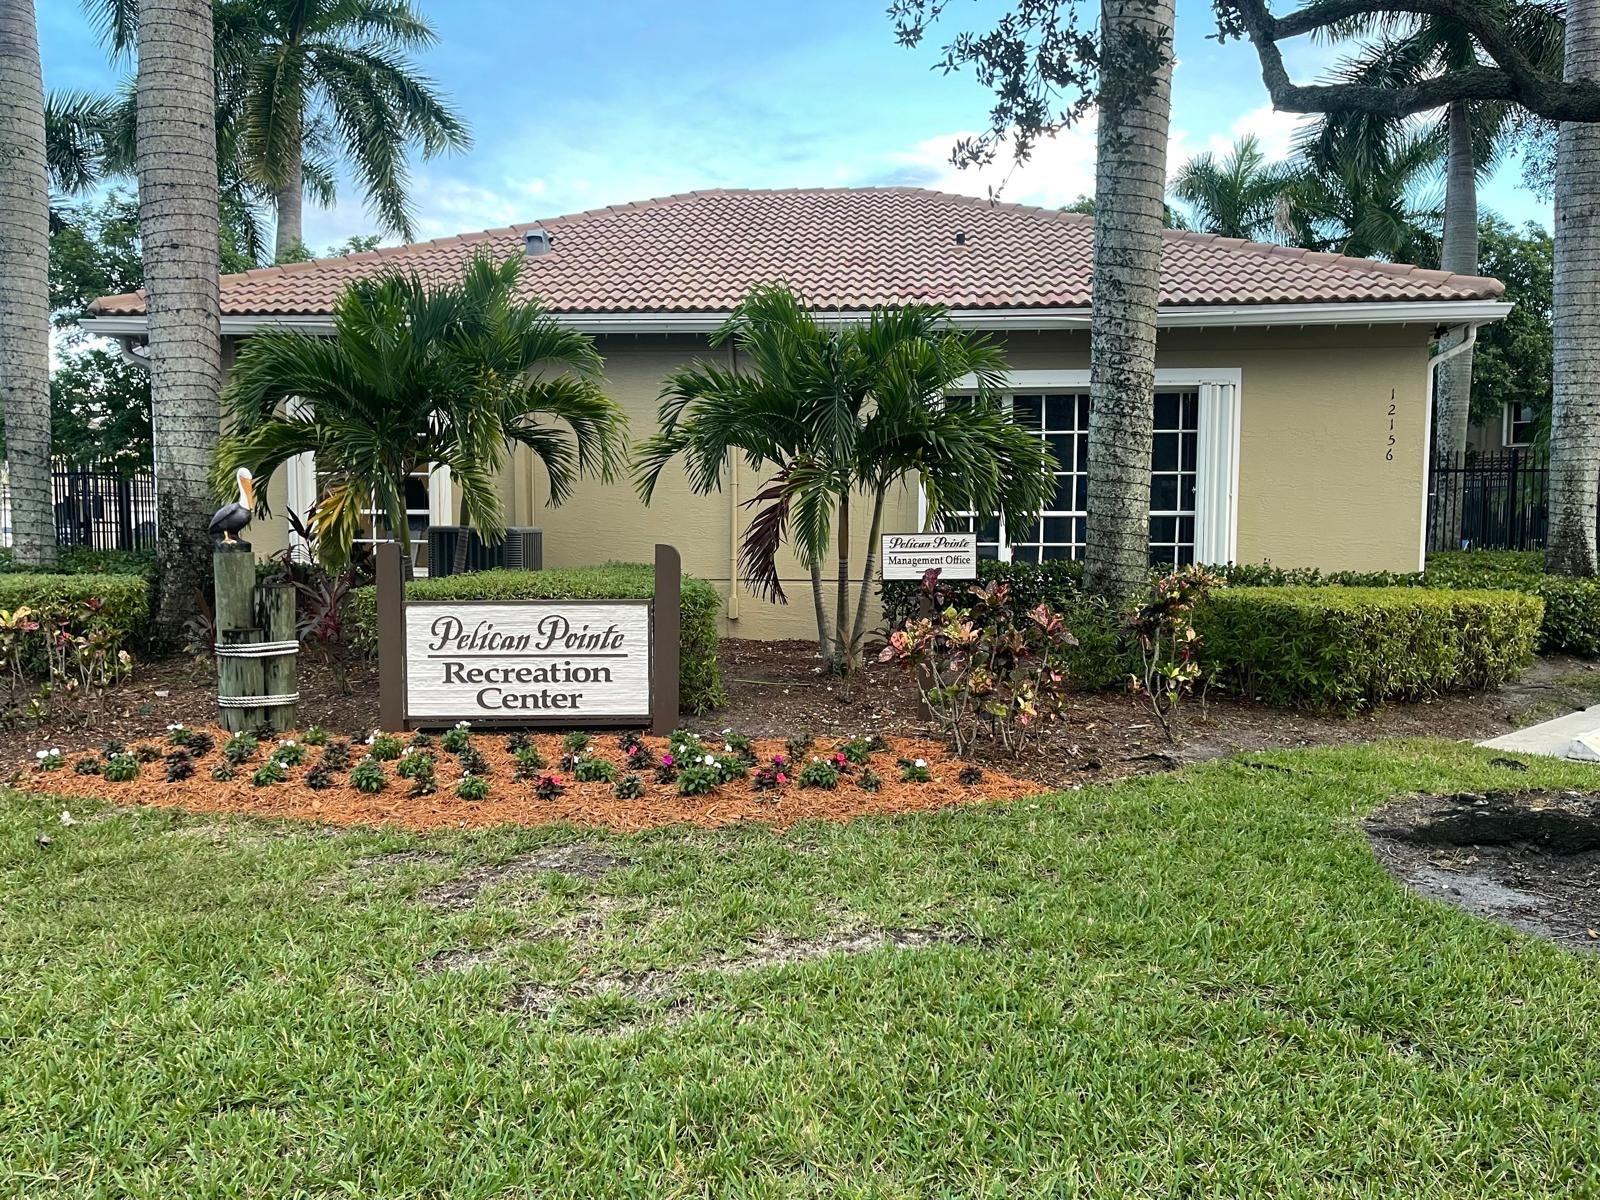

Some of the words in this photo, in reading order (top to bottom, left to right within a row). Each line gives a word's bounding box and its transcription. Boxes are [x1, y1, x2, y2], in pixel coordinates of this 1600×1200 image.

[1385, 387, 1396, 461] 12156
[888, 536, 931, 550] Pelican
[932, 536, 970, 549] Pointe
[888, 555, 944, 567] Management
[945, 555, 971, 565] Office
[428, 615, 531, 652] Pelican
[535, 614, 625, 652] Pointe
[442, 660, 613, 684] Recreation
[476, 687, 583, 710] Center
